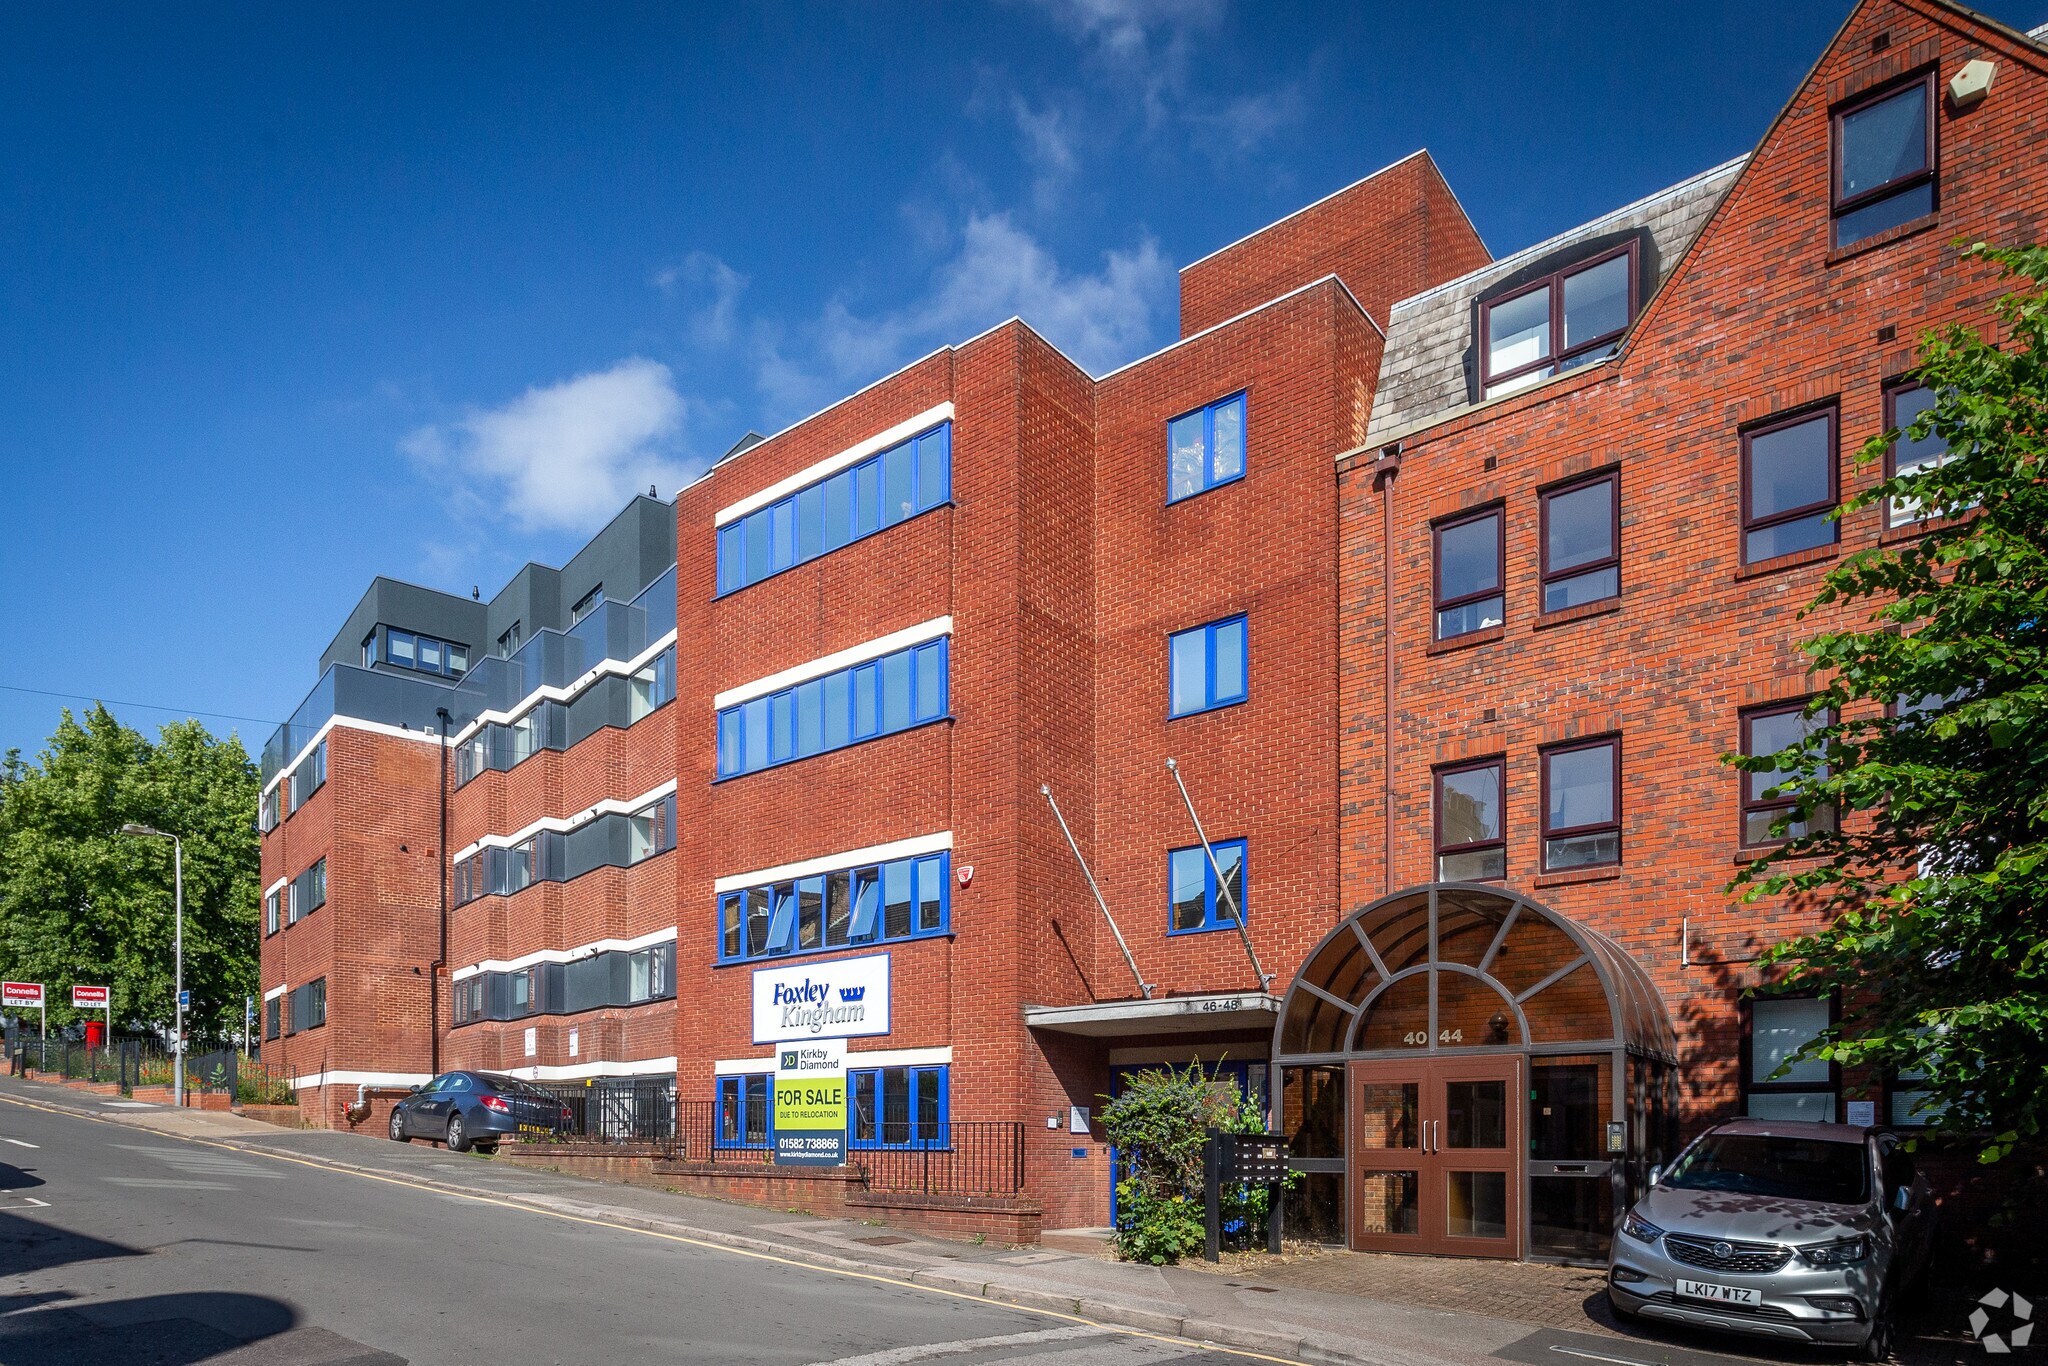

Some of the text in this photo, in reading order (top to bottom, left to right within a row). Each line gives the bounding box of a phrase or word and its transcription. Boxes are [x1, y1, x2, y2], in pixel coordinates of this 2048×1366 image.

[6, 987, 39, 996] Connells
[76, 990, 105, 998] Connells
[772, 978, 830, 1008] Foxley
[1202, 1000, 1238, 1011] 46-48
[780, 1000, 865, 1034] Kingham
[1403, 1029, 1463, 1044] 40 44
[800, 1048, 828, 1060] Kirkby
[800, 1058, 839, 1070] Diamond
[777, 1089, 842, 1106] FOR SALE
[779, 1110, 838, 1119] DUE TO RELOCATION
[779, 1138, 839, 1150] 01582 738866
[779, 1151, 839, 1159] www.kirkbydiamond.co.uk
[1685, 1281, 1752, 1303] LK17 WTZ
